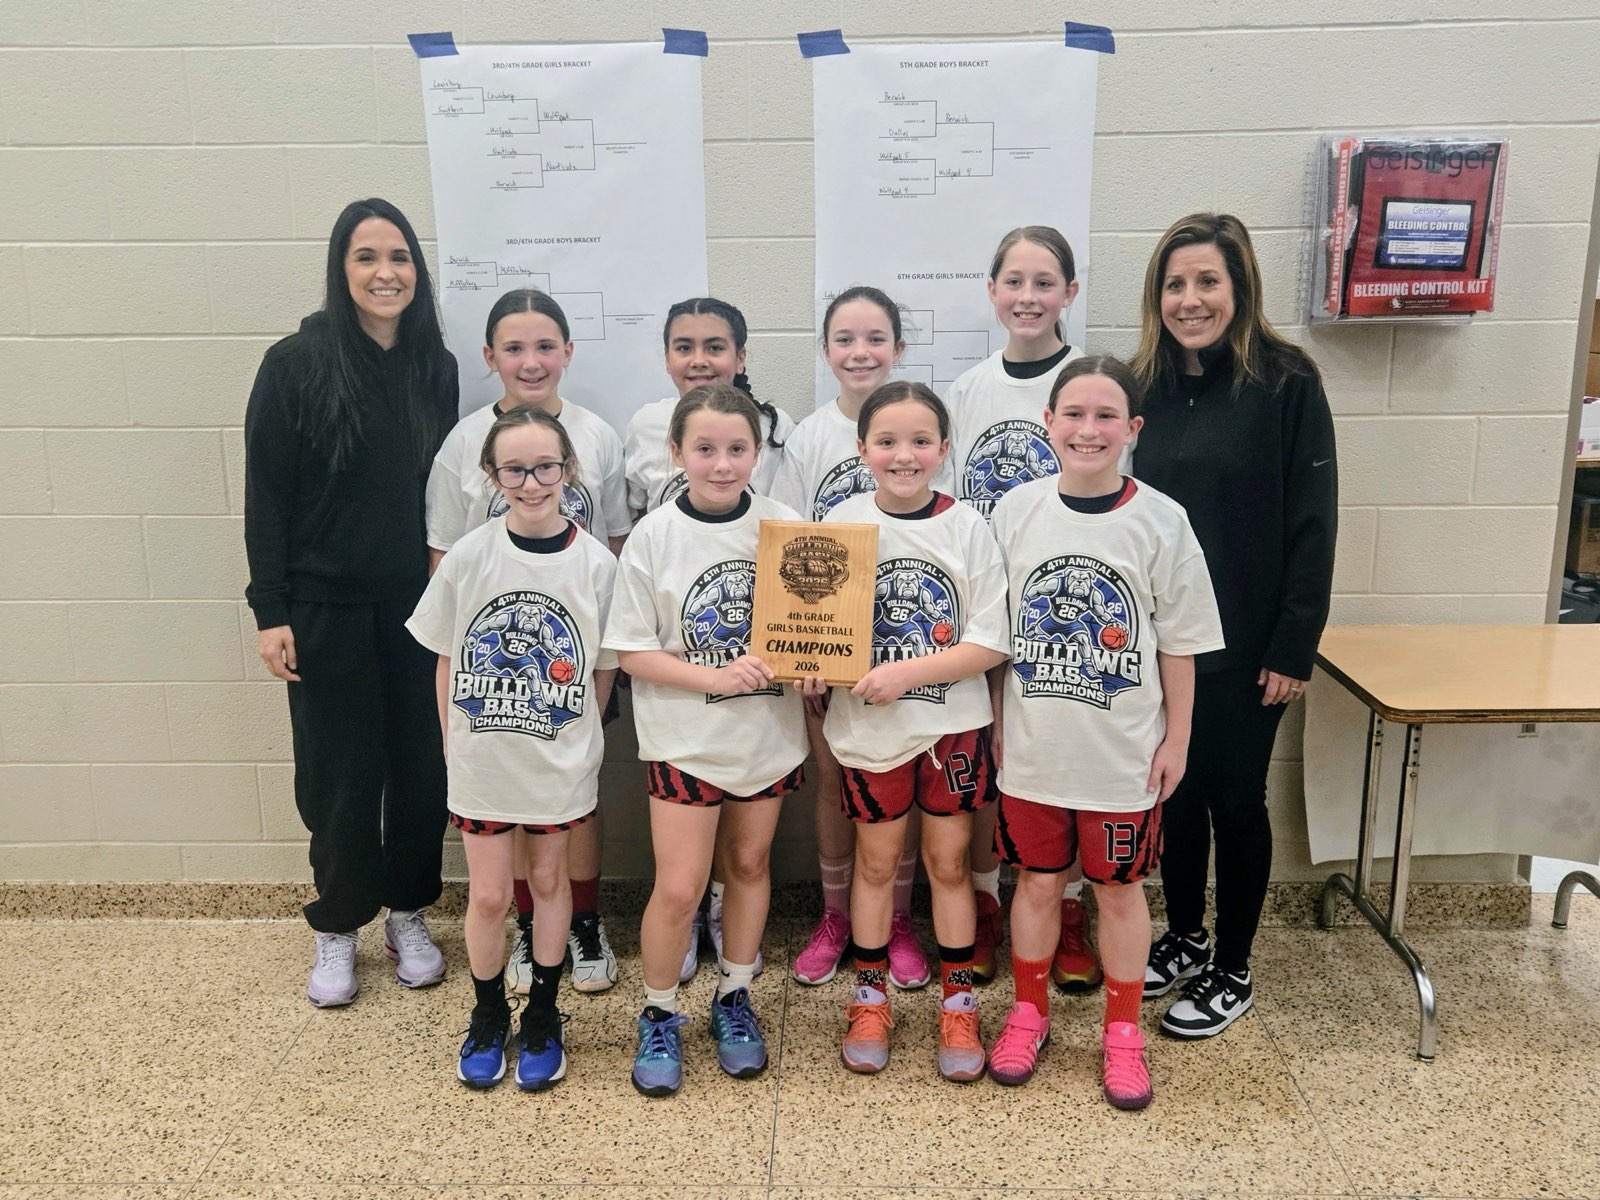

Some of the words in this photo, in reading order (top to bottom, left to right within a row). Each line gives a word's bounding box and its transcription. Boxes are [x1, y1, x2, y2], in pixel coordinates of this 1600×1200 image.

[564, 60, 591, 68] BRACKET
[1368, 145, 1493, 177] Geisinger
[1337, 150, 1348, 213] BLEEDING
[1412, 206, 1451, 217] Geisinger
[1388, 221, 1428, 230] BLEEDING
[1430, 222, 1468, 230] CONTROL
[574, 236, 600, 244] BRACKET
[1354, 282, 1408, 297] BLEEDING
[1412, 281, 1464, 296] CONTROL
[1467, 280, 1488, 294] KIT
[989, 423, 1006, 436] 4TH
[1008, 422, 1046, 437] ANNUAL
[840, 459, 857, 472] 4TH
[1000, 464, 1016, 477] 26
[1041, 459, 1055, 470] 26
[974, 470, 985, 480] 20
[809, 536, 837, 544] ANNUAL
[702, 566, 720, 582] 4TH
[722, 562, 756, 572] ANNUA
[876, 562, 892, 577] 4TH
[894, 560, 938, 576] ANNUAL
[1047, 559, 1065, 571] 4TH
[1068, 557, 1112, 578] ANNUAL
[498, 594, 516, 607] 4TH
[519, 593, 562, 613] ANNUAL
[936, 599, 949, 610] 26
[1107, 602, 1122, 613] 26
[728, 608, 744, 622] 26
[787, 612, 802, 620] 4th
[804, 612, 836, 622] GRADE
[890, 607, 910, 620] 26
[1029, 608, 1040, 619] 20
[1058, 605, 1078, 619] 26
[696, 621, 710, 633] 20
[766, 623, 794, 633] GIRLS
[796, 625, 854, 636] BASKETBALL
[478, 643, 490, 654] 20
[508, 639, 528, 654] 26
[556, 637, 569, 648] 26
[766, 640, 854, 656] CHAMPIONS
[794, 661, 820, 672] 2026
[1028, 682, 1105, 703] CHAMPIONS
[475, 717, 553, 735] CHAMPIONS
[944, 752, 976, 794] 12
[1102, 821, 1137, 864] 13
